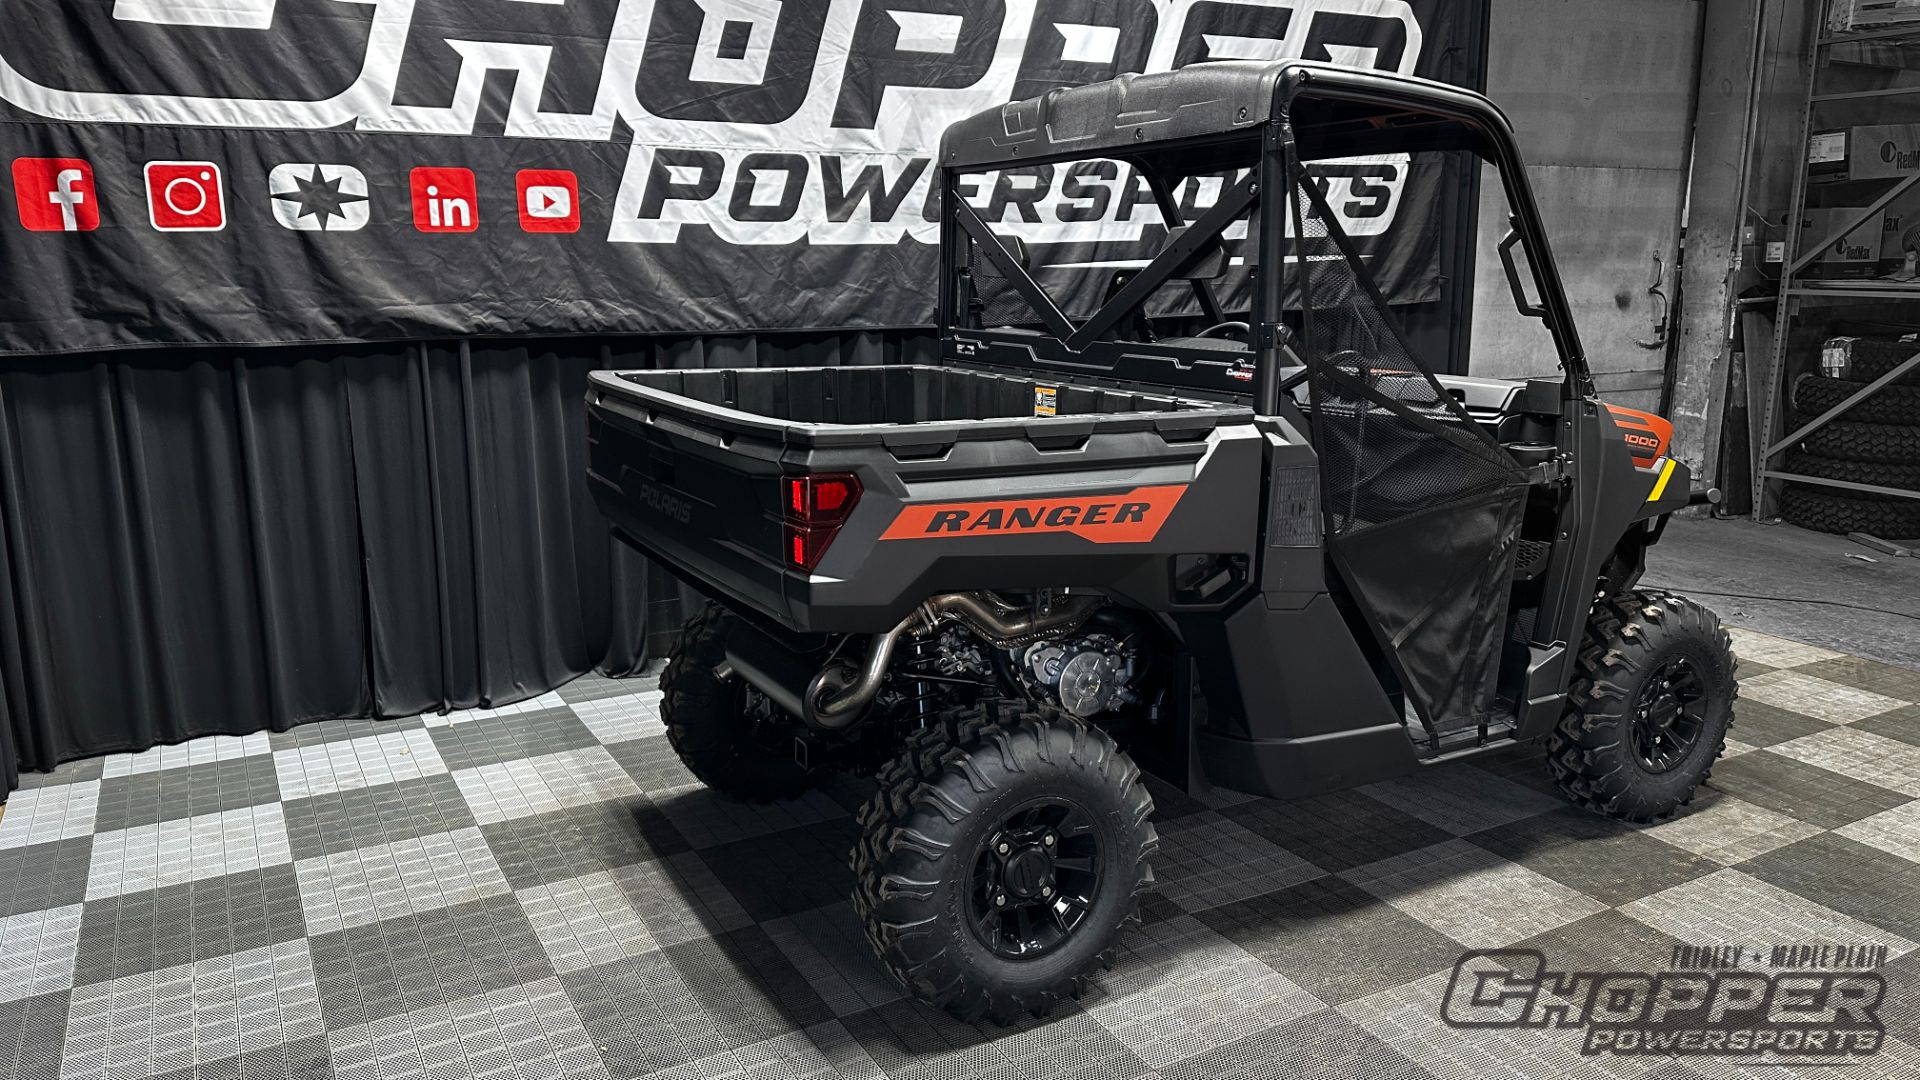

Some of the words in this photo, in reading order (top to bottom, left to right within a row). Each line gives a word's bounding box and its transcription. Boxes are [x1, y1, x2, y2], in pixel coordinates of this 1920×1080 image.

[1896, 150, 1920, 170] RedM
[636, 147, 1398, 222] POWERSPOTS
[1624, 433, 1659, 447] 1000
[640, 484, 692, 523] POLARIS
[924, 502, 1151, 533] RANGER
